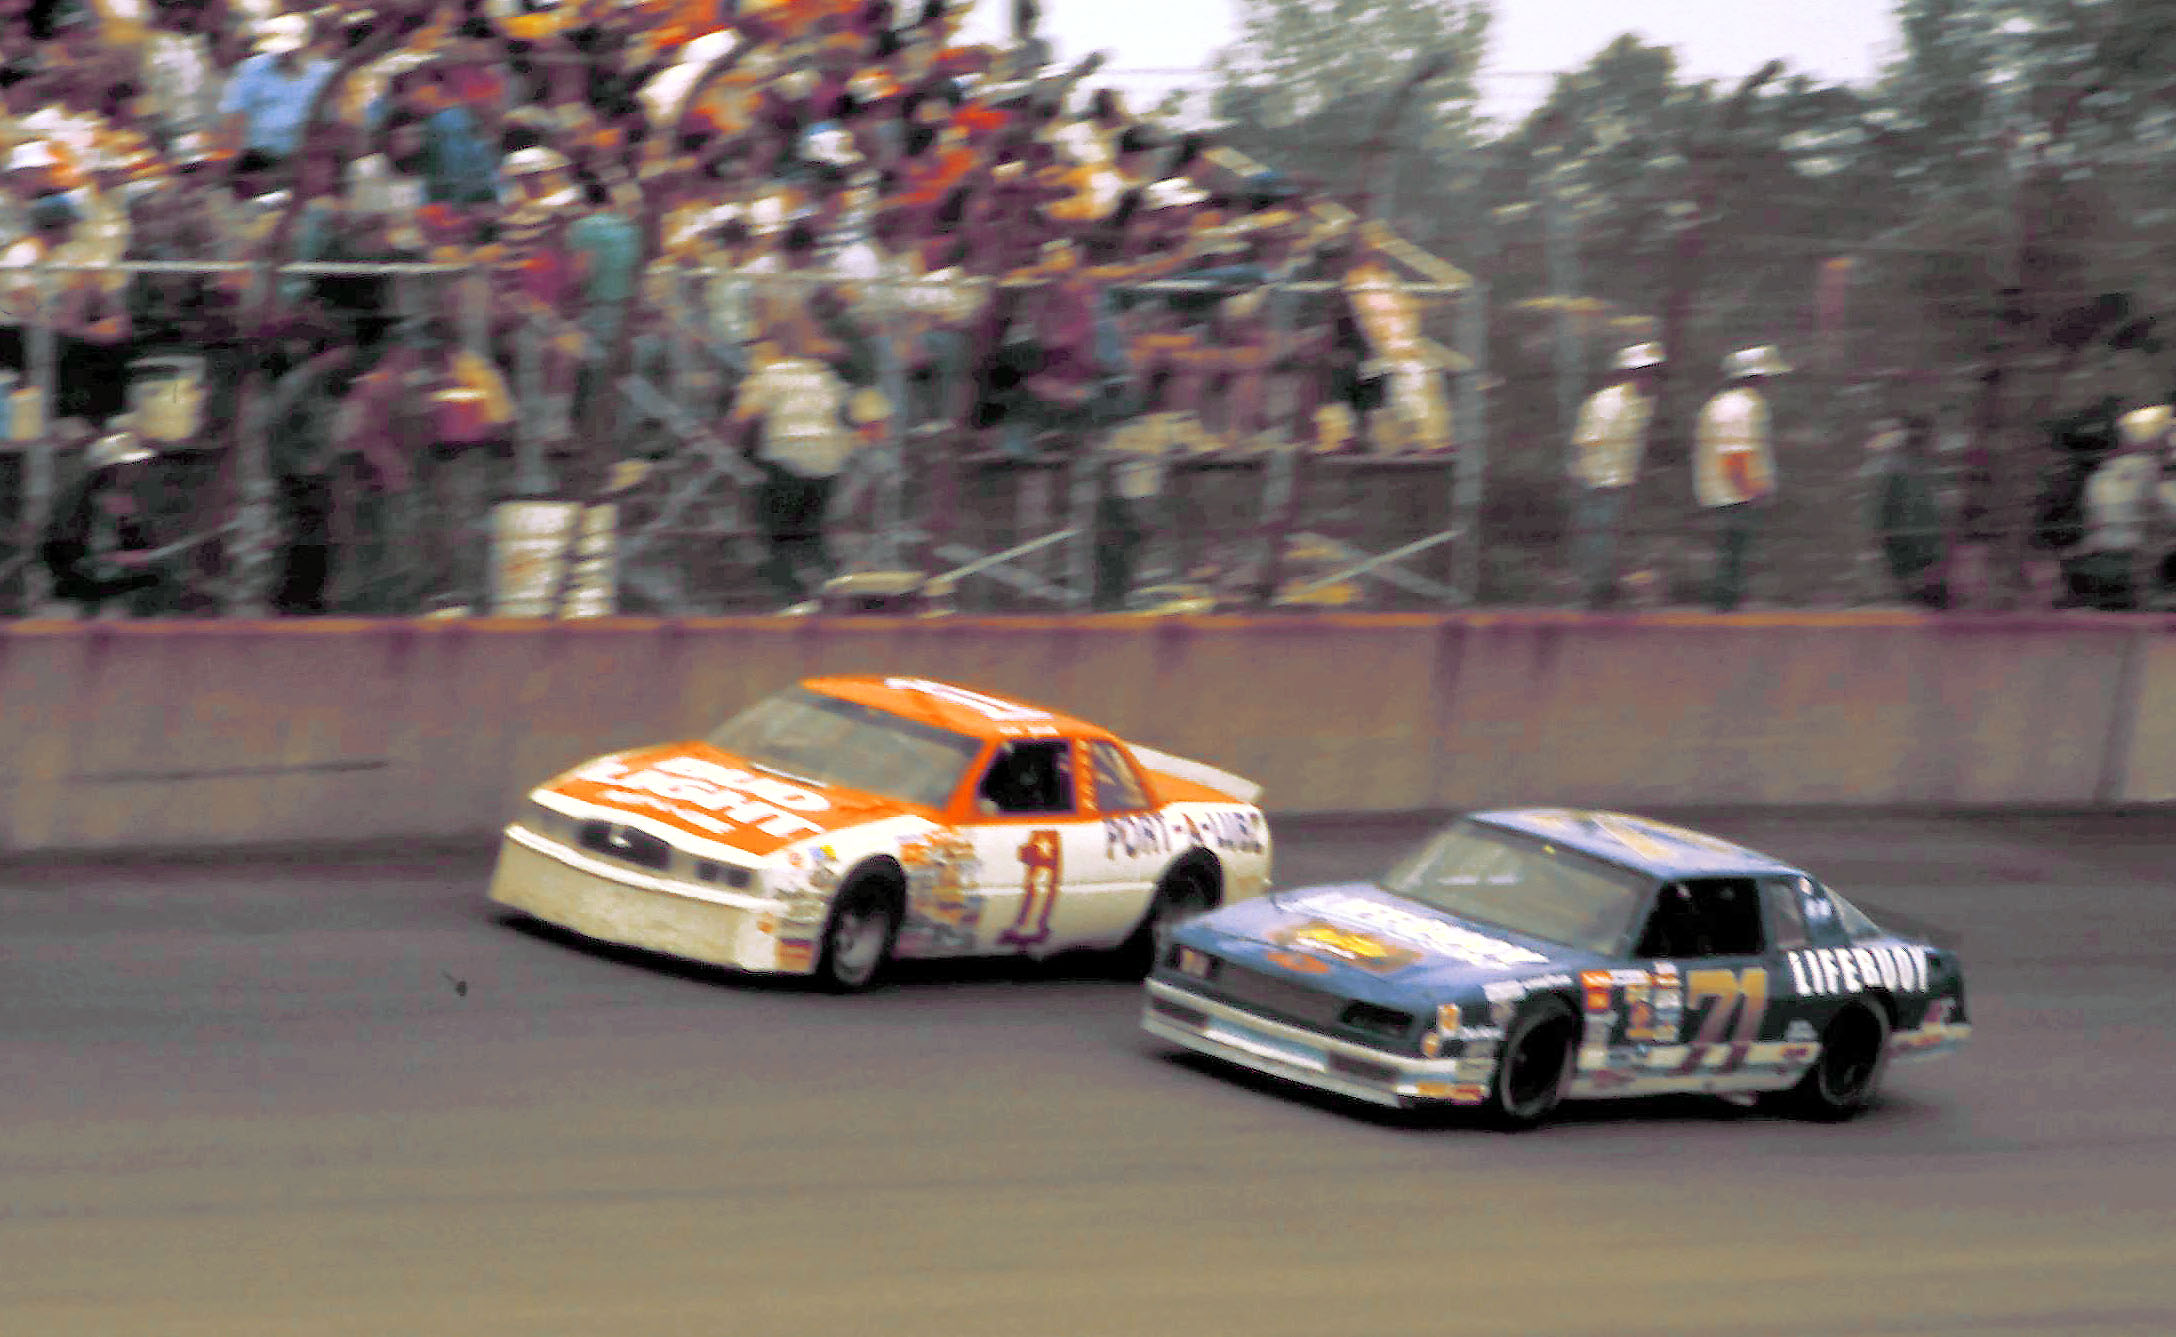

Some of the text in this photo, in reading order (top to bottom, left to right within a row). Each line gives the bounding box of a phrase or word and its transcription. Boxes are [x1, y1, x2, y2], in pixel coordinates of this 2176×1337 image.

[576, 756, 826, 838] LIGHT
[1787, 945, 1929, 997] LIFEBUOY
[1678, 967, 1768, 1075] 71
